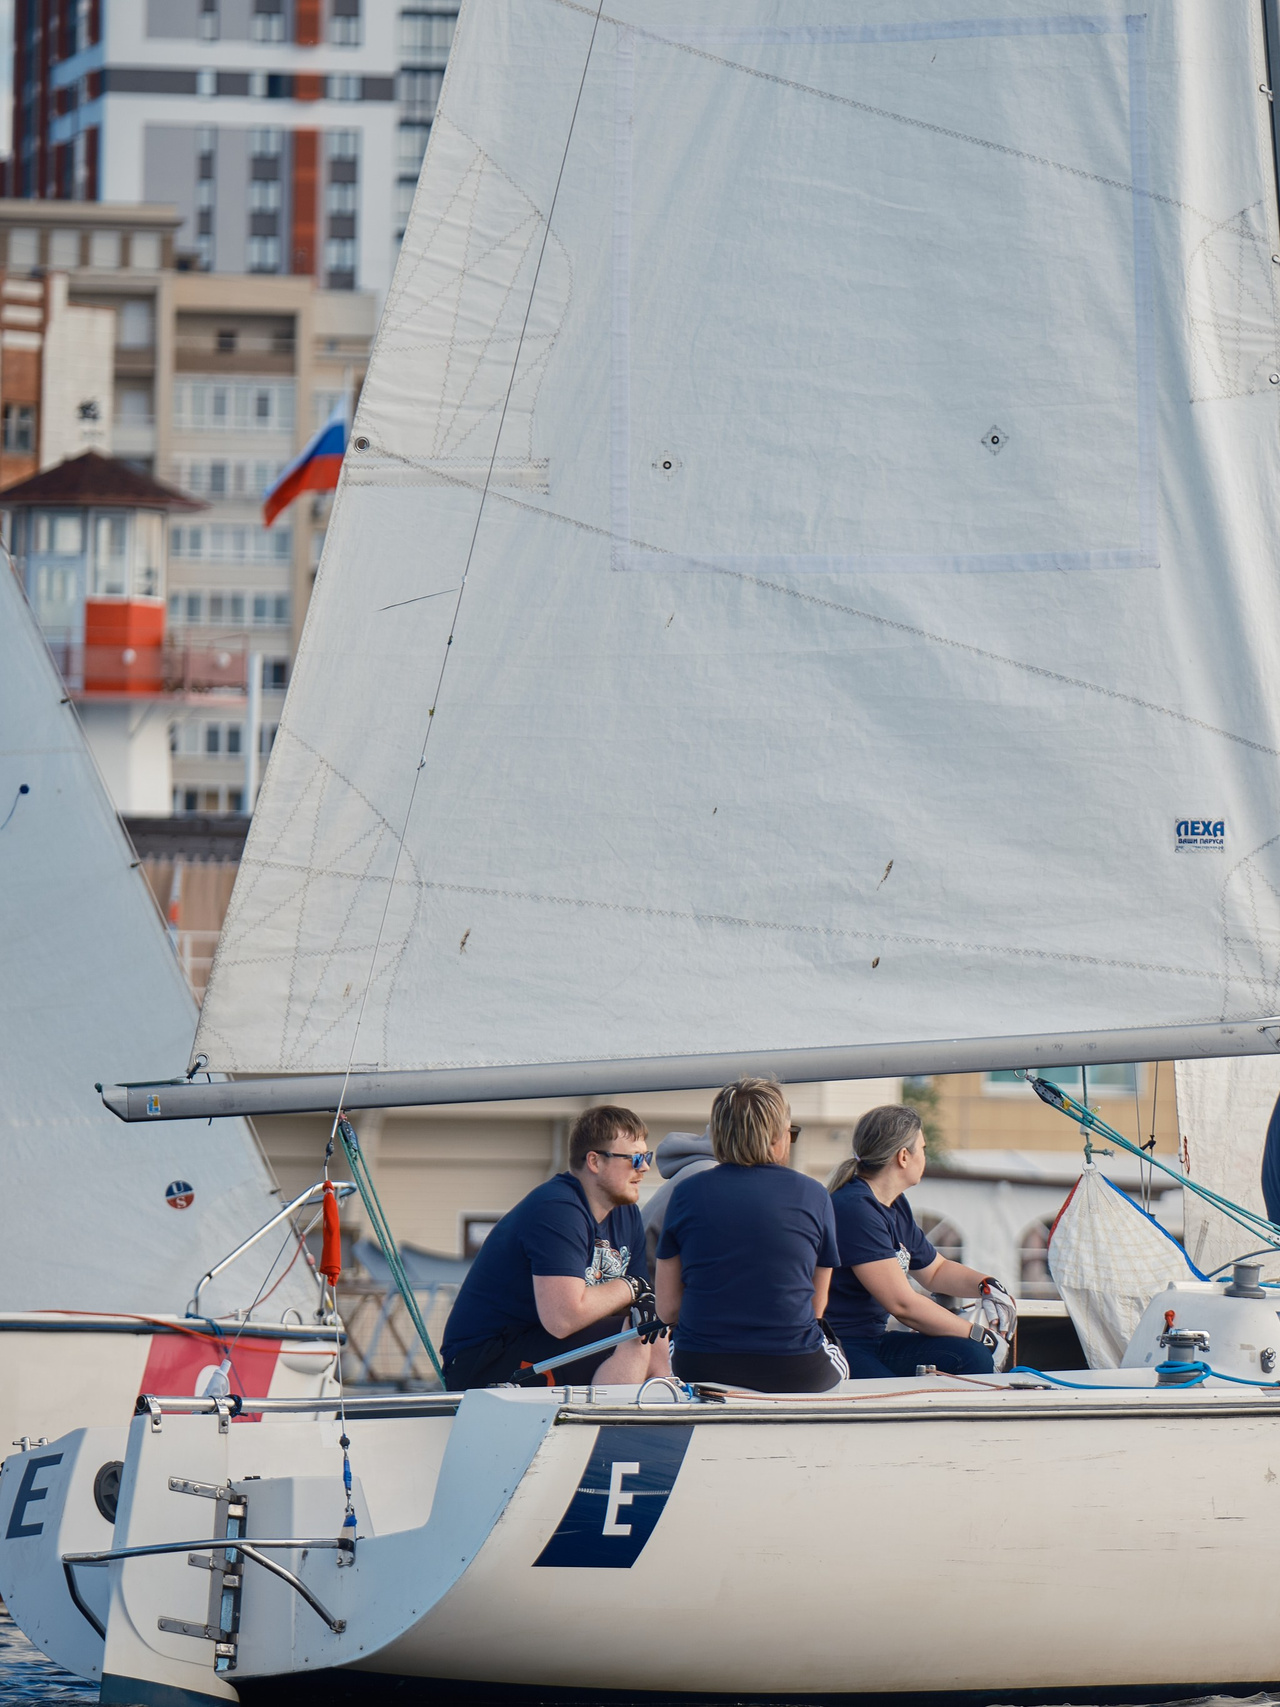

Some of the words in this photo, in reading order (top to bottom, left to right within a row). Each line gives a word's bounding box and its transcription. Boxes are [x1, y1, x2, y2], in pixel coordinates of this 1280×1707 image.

[1176, 820, 1225, 837] ЛЕХА
[5, 1453, 64, 1539] E
[602, 1461, 640, 1536] E
